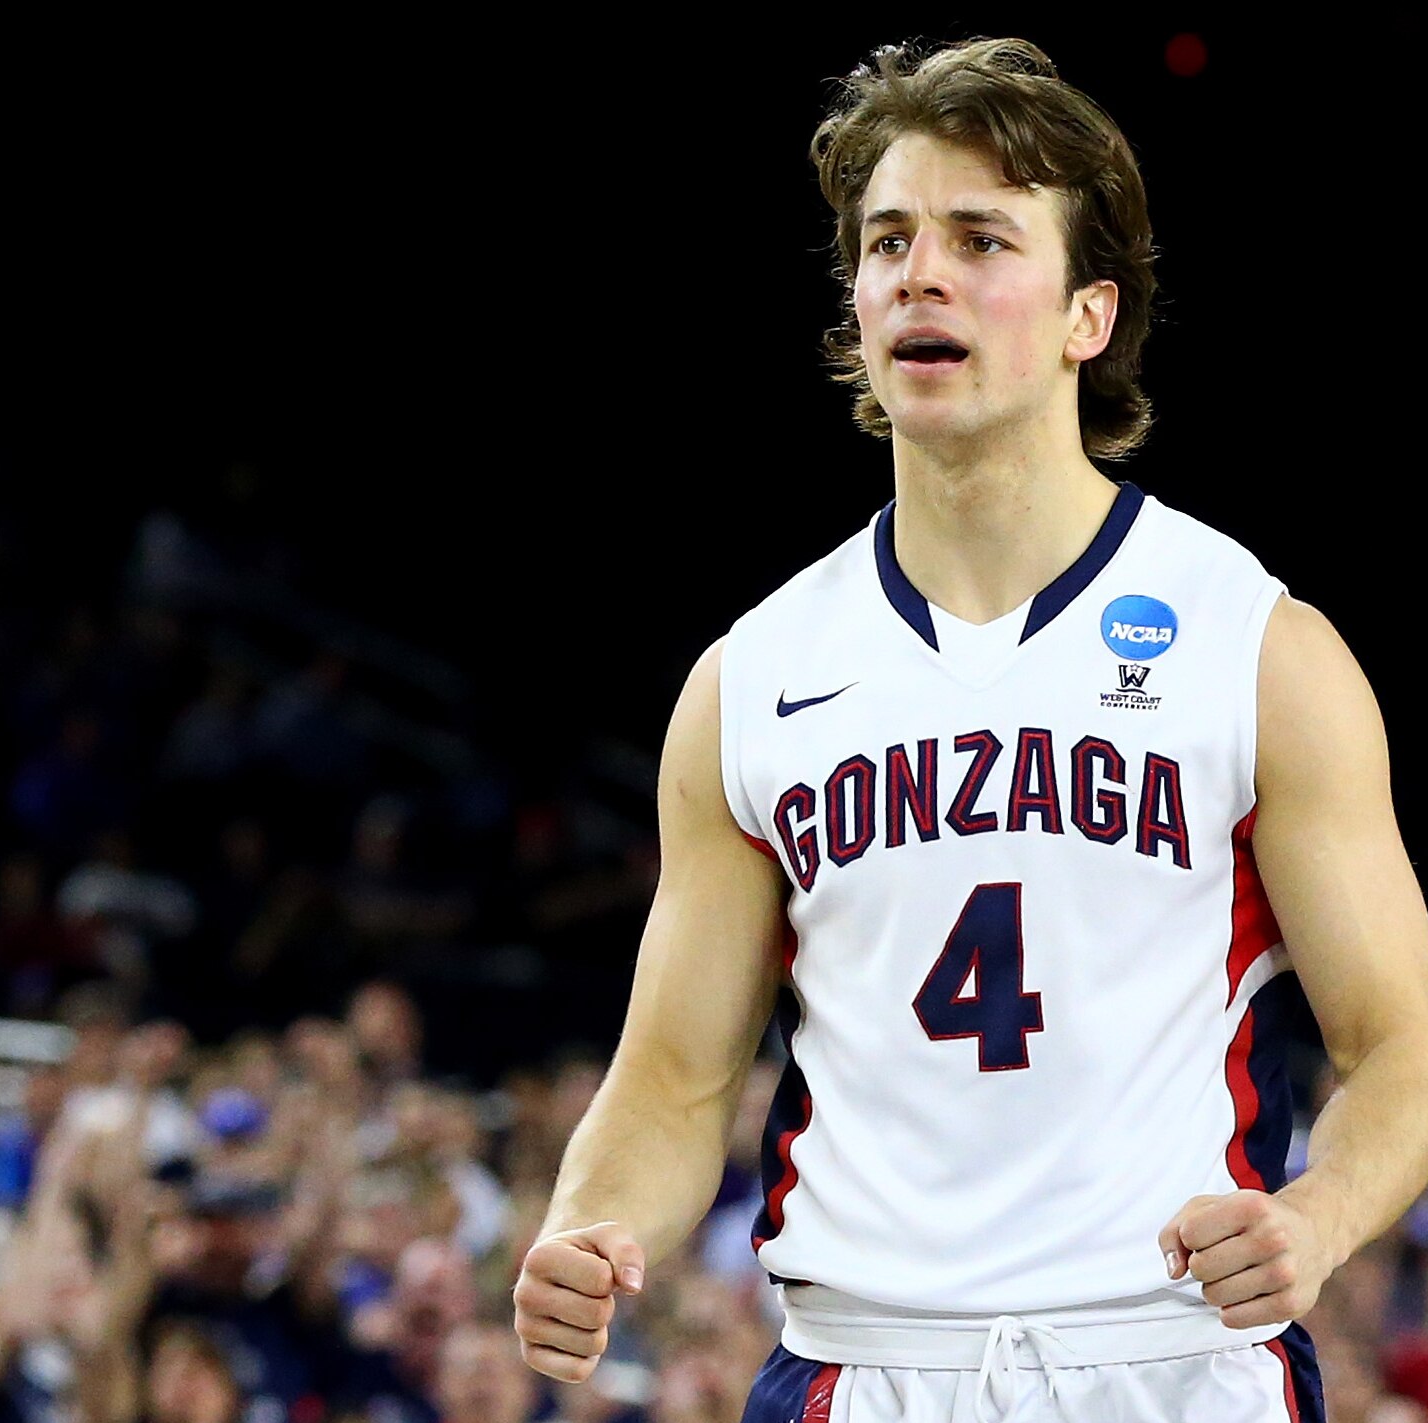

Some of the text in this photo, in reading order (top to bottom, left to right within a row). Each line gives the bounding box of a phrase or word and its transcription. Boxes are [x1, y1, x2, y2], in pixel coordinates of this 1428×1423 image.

[1109, 621, 1173, 644] NCAA
[1100, 693, 1162, 704] WEST COAST
[1100, 702, 1158, 710] CONFERENCE
[774, 727, 1192, 893] GONZAGA
[913, 882, 1044, 1072] 4
